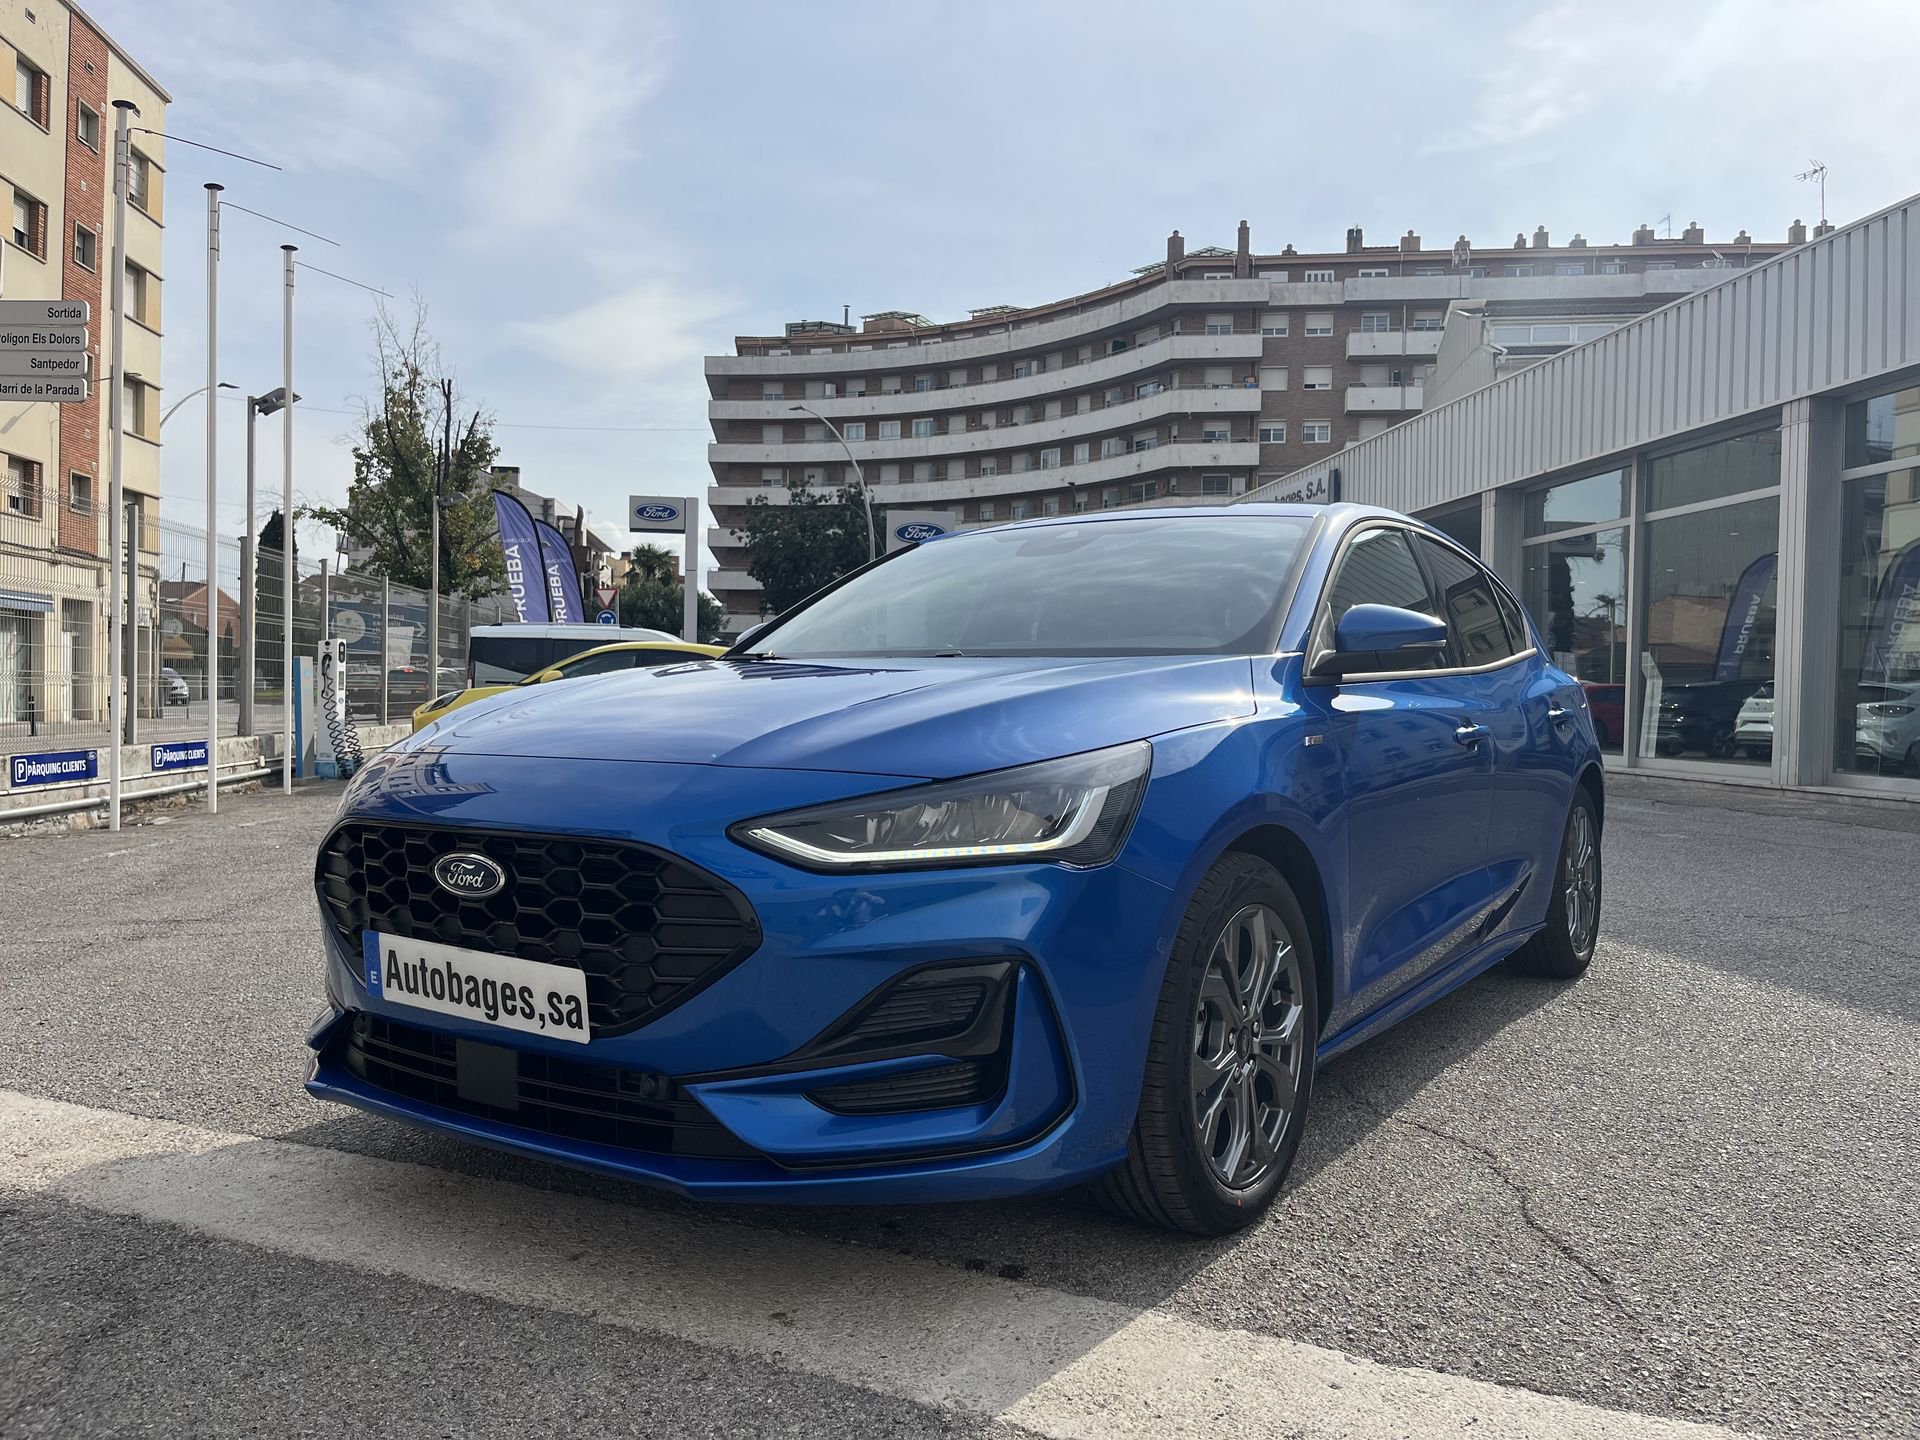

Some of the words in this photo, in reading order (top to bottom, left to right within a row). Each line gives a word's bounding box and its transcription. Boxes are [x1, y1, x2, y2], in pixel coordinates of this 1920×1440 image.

[47, 307, 82, 318] Sortida
[32, 333, 47, 344] Els
[47, 333, 80, 344] Dolors
[30, 358, 80, 371] Santpedor
[20, 383, 32, 394] de
[35, 384, 43, 394] la
[46, 384, 79, 395] Parada
[1306, 478, 1326, 500] S.A.
[904, 525, 936, 539] Ford
[61, 759, 86, 773] CLIENTS
[447, 861, 485, 888] Ford
[370, 970, 378, 985] E
[386, 949, 584, 1030] Autobages,sa
